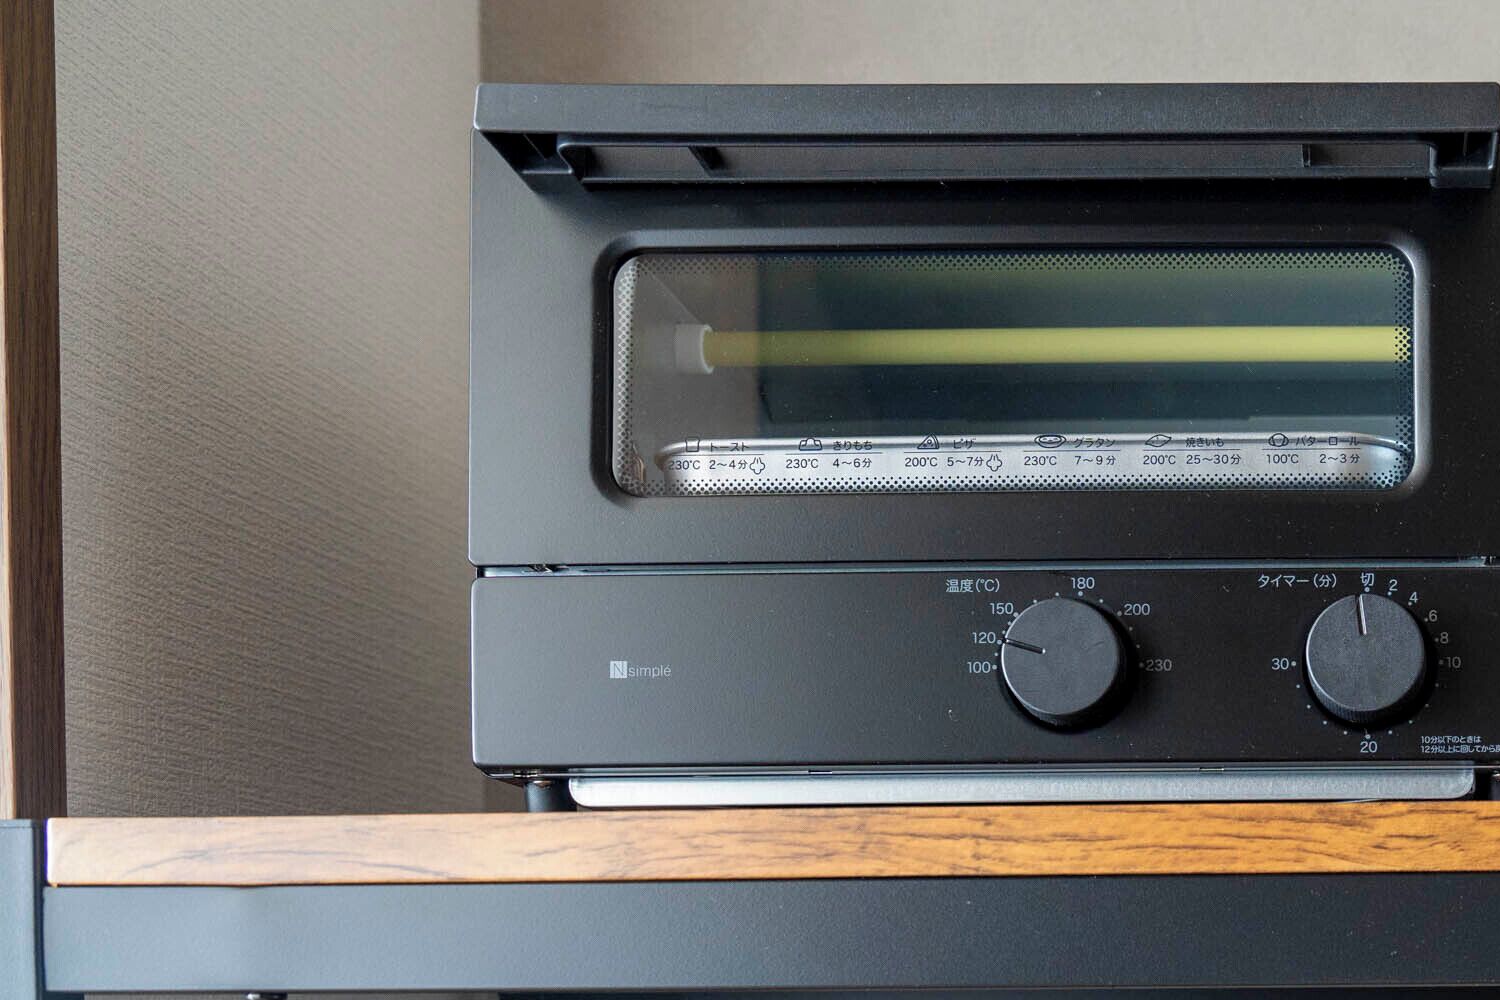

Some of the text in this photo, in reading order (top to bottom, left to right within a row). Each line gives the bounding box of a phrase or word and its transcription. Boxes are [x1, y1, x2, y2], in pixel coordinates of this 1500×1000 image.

[710, 442, 750, 453] トースト
[832, 440, 873, 451] きりもち
[953, 437, 977, 450] ピザ
[1073, 437, 1116, 449] グラタン
[1185, 437, 1225, 448] 焼きいも
[1071, 576, 1096, 590] 180
[1360, 572, 1375, 587] 切
[1388, 579, 1398, 592] 2
[1409, 592, 1419, 604] 4
[989, 602, 1014, 615] 150
[1124, 602, 1151, 616] 200
[1428, 610, 1438, 622] 6
[972, 631, 996, 645] 120
[1439, 632, 1450, 644] 8
[967, 661, 991, 674] 100
[1144, 659, 1172, 672] 230
[1271, 658, 1289, 670] 30
[1446, 656, 1462, 669] 10
[1420, 735, 1482, 744] 10分以下のときは
[1359, 740, 1378, 754] 20
